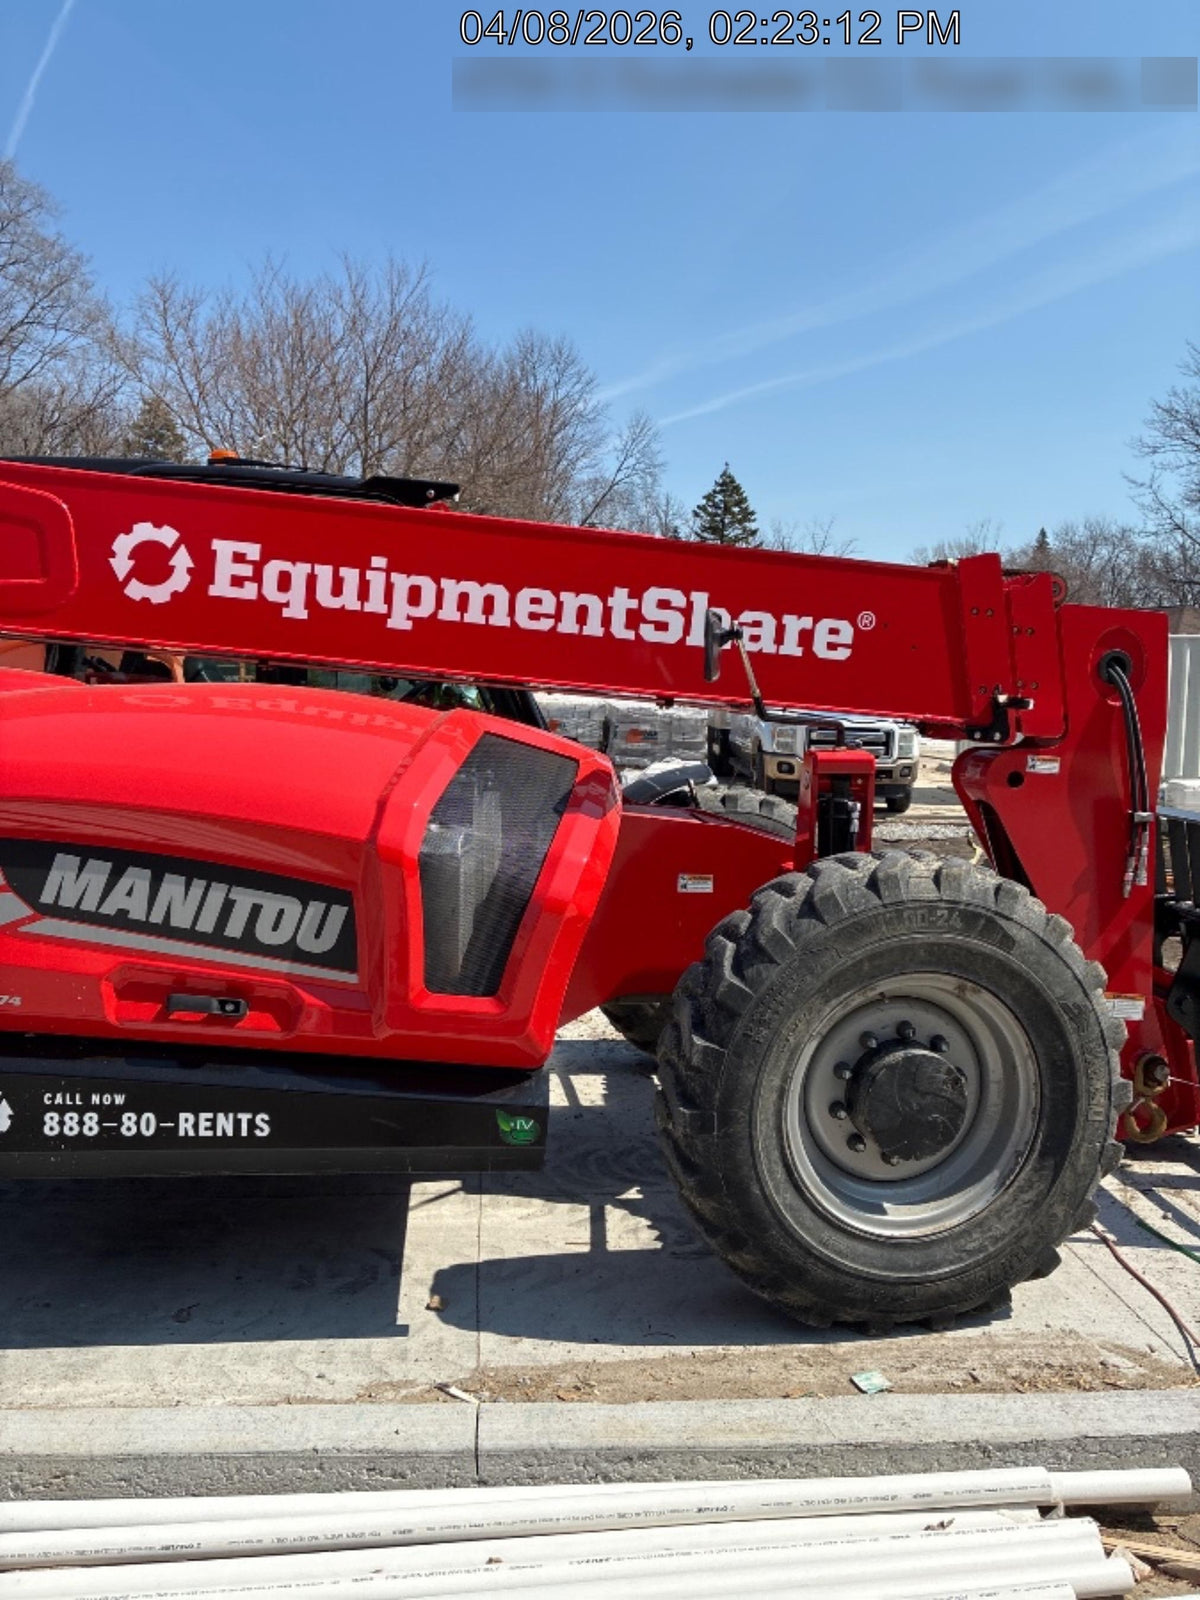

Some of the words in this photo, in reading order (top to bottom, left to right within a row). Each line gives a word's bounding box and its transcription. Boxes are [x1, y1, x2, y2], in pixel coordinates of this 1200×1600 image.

[39, 852, 349, 953] MANITOU
[43, 1093, 83, 1105] CALL
[91, 1093, 126, 1105] NOW
[43, 1112, 271, 1137] 888-80-RENTS
